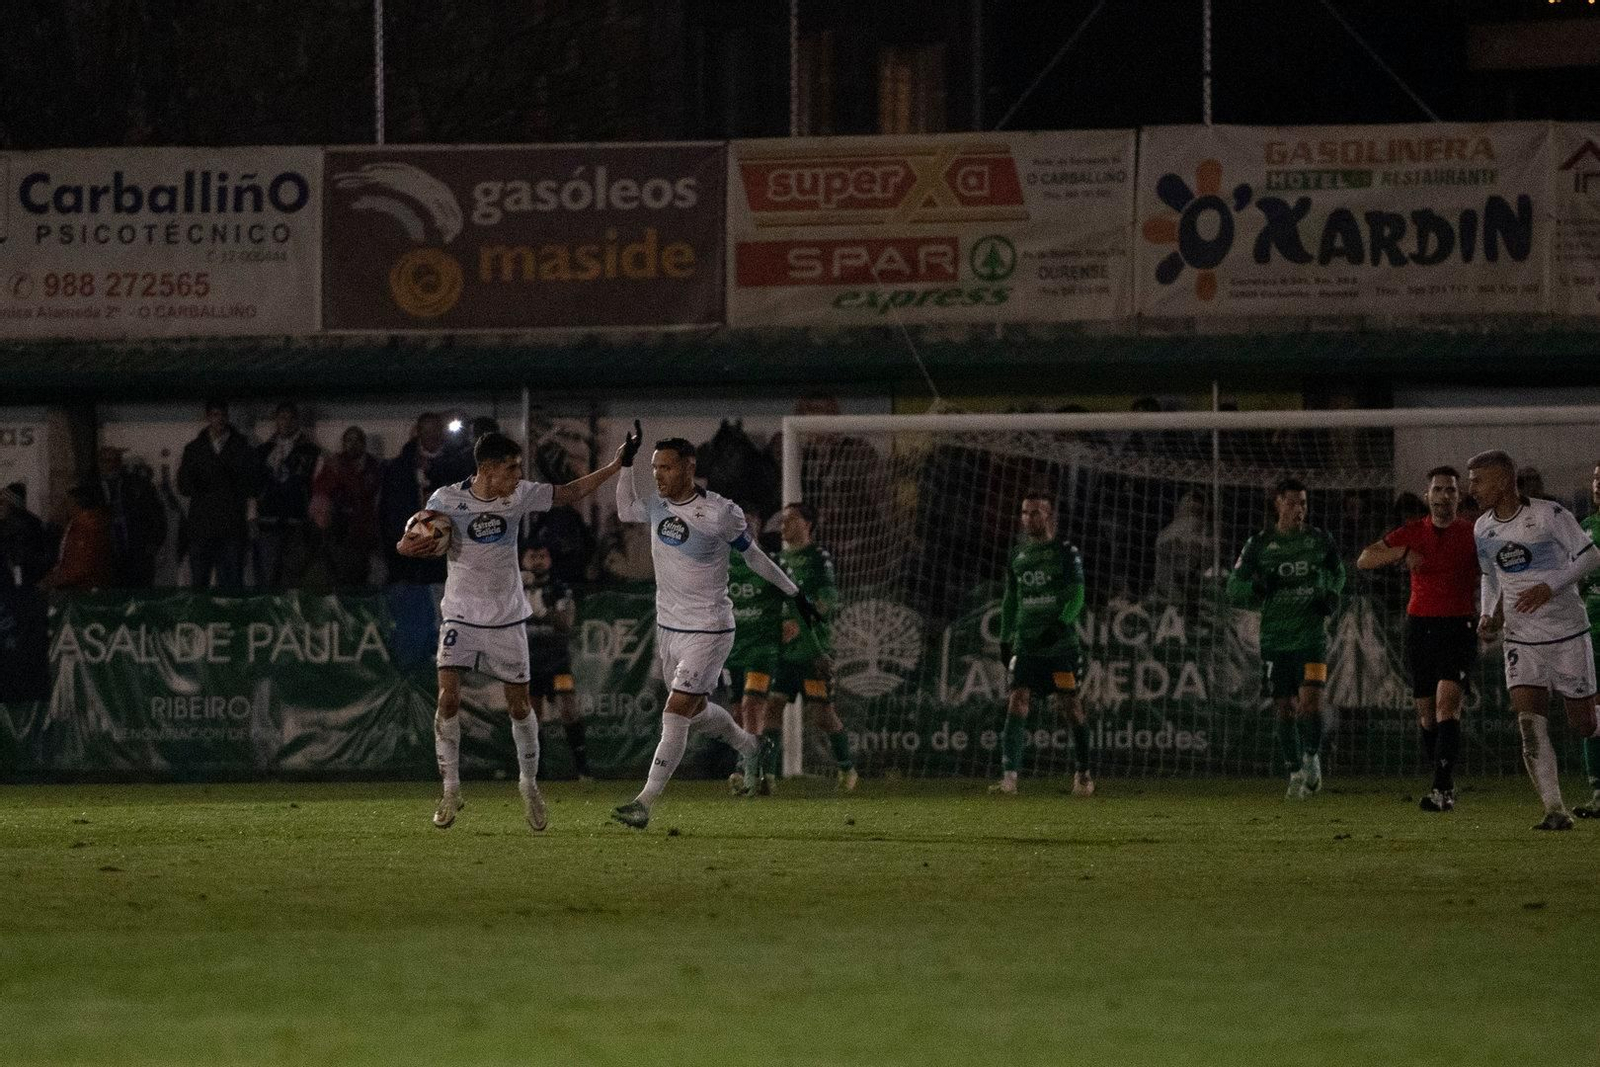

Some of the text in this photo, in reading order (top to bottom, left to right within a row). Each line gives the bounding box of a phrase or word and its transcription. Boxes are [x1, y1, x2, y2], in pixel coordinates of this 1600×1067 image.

[471, 165, 698, 226] gasóleos
[35, 220, 291, 245] PSICOTÉCNICO
[478, 226, 697, 284] maside
[787, 243, 956, 280] SPAR
[44, 272, 210, 297] 988 272565
[833, 287, 1013, 315] express
[49, 621, 391, 664] ASAL DE PAULA
[444, 629, 458, 646] 8
[580, 619, 638, 660] DE
[151, 697, 250, 719] RIBEIRO
[931, 721, 968, 750] de
